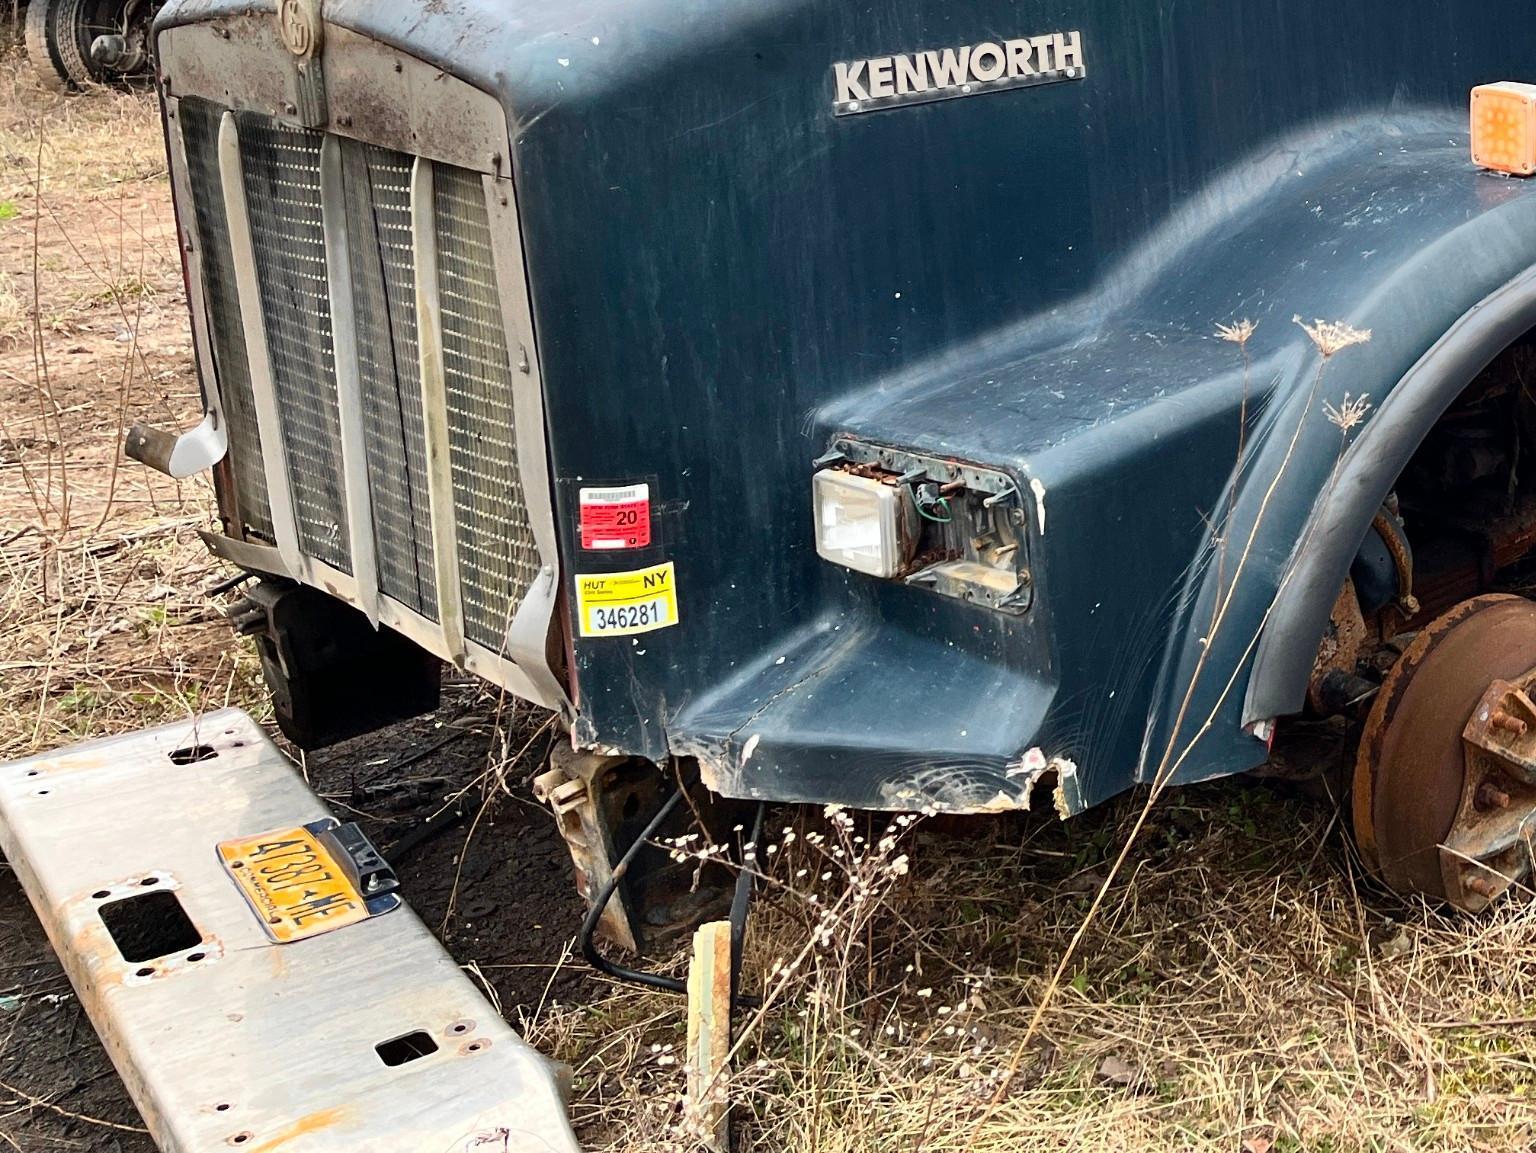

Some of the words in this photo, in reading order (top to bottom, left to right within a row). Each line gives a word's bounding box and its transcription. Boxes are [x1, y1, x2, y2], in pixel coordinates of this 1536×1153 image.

[834, 30, 1083, 104] KENWORTH
[616, 510, 638, 526] 20
[584, 580, 606, 590] HUT
[643, 570, 667, 589] NY
[596, 601, 658, 630] 346281
